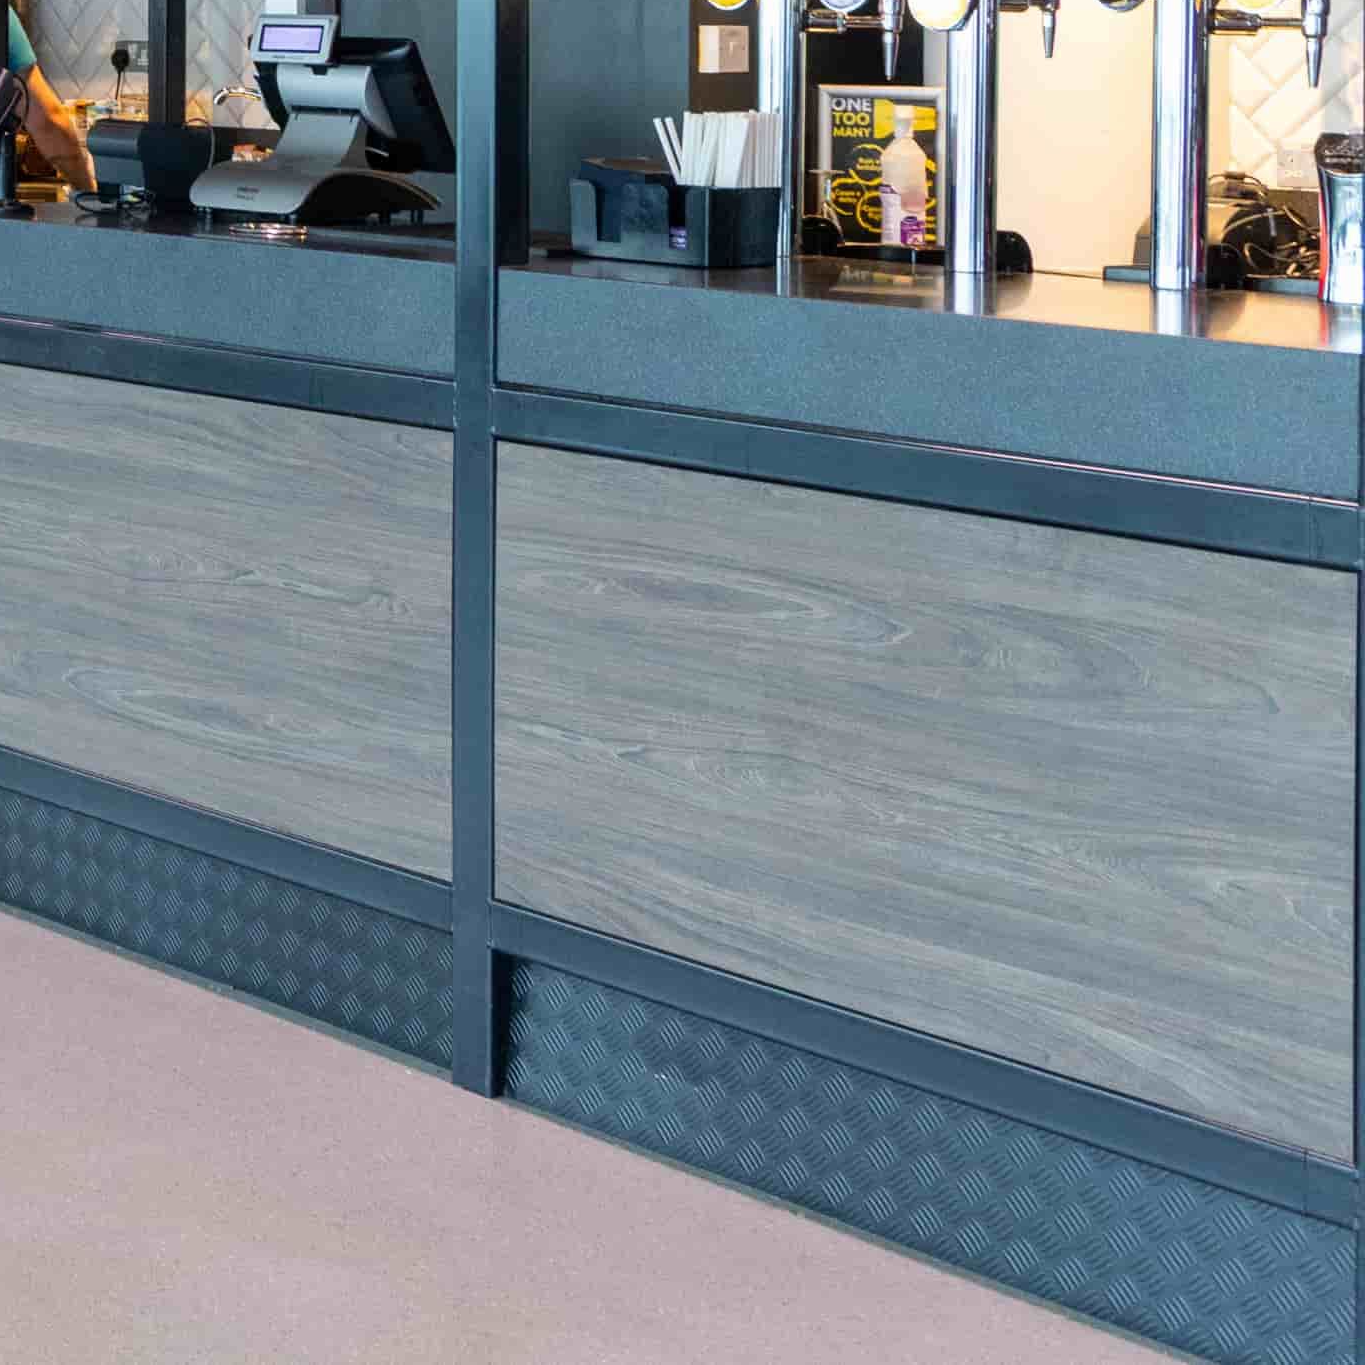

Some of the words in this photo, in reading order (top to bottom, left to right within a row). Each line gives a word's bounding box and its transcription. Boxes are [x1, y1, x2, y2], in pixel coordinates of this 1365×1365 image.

[831, 97, 872, 112] ONE
[832, 112, 870, 126] TOO
[832, 126, 871, 139] MANY
